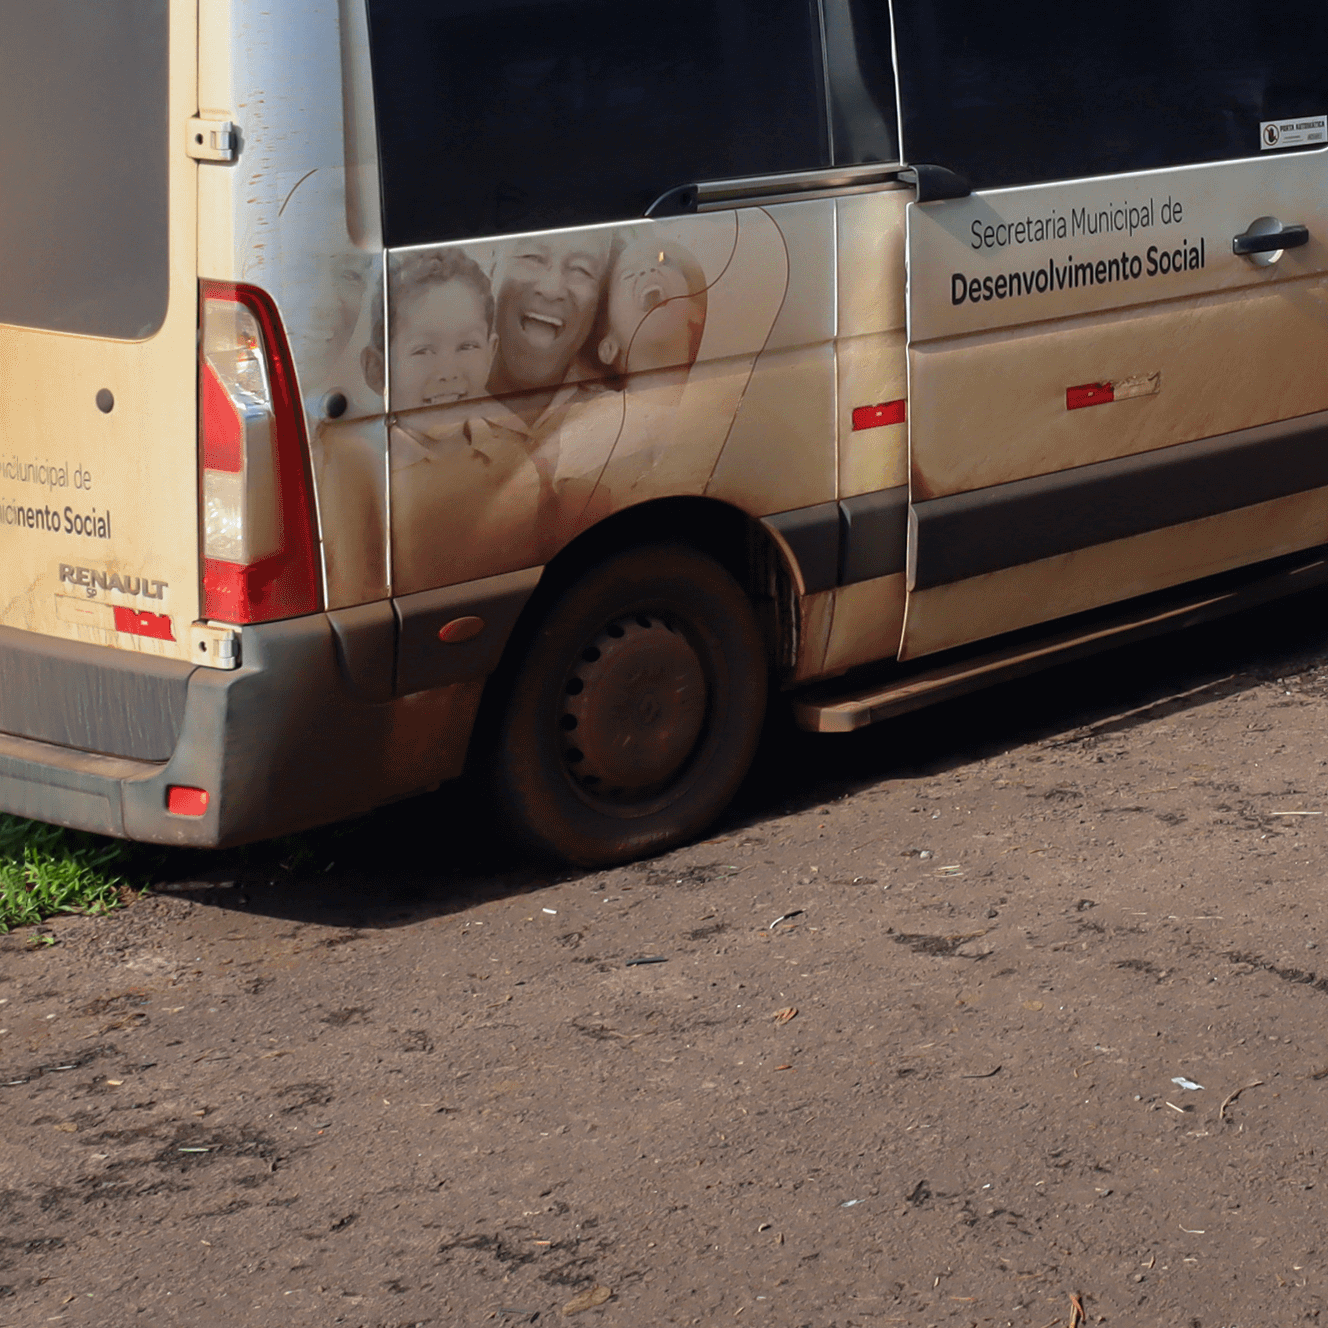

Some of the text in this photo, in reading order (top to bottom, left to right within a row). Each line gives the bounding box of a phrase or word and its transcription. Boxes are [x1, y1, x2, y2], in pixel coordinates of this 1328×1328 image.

[971, 196, 1183, 249] Secretaria Municipal de
[951, 237, 1205, 305] Desenvolvimento Social
[74, 463, 92, 490] de
[64, 506, 111, 539] Social
[59, 563, 169, 600] RENAULT
